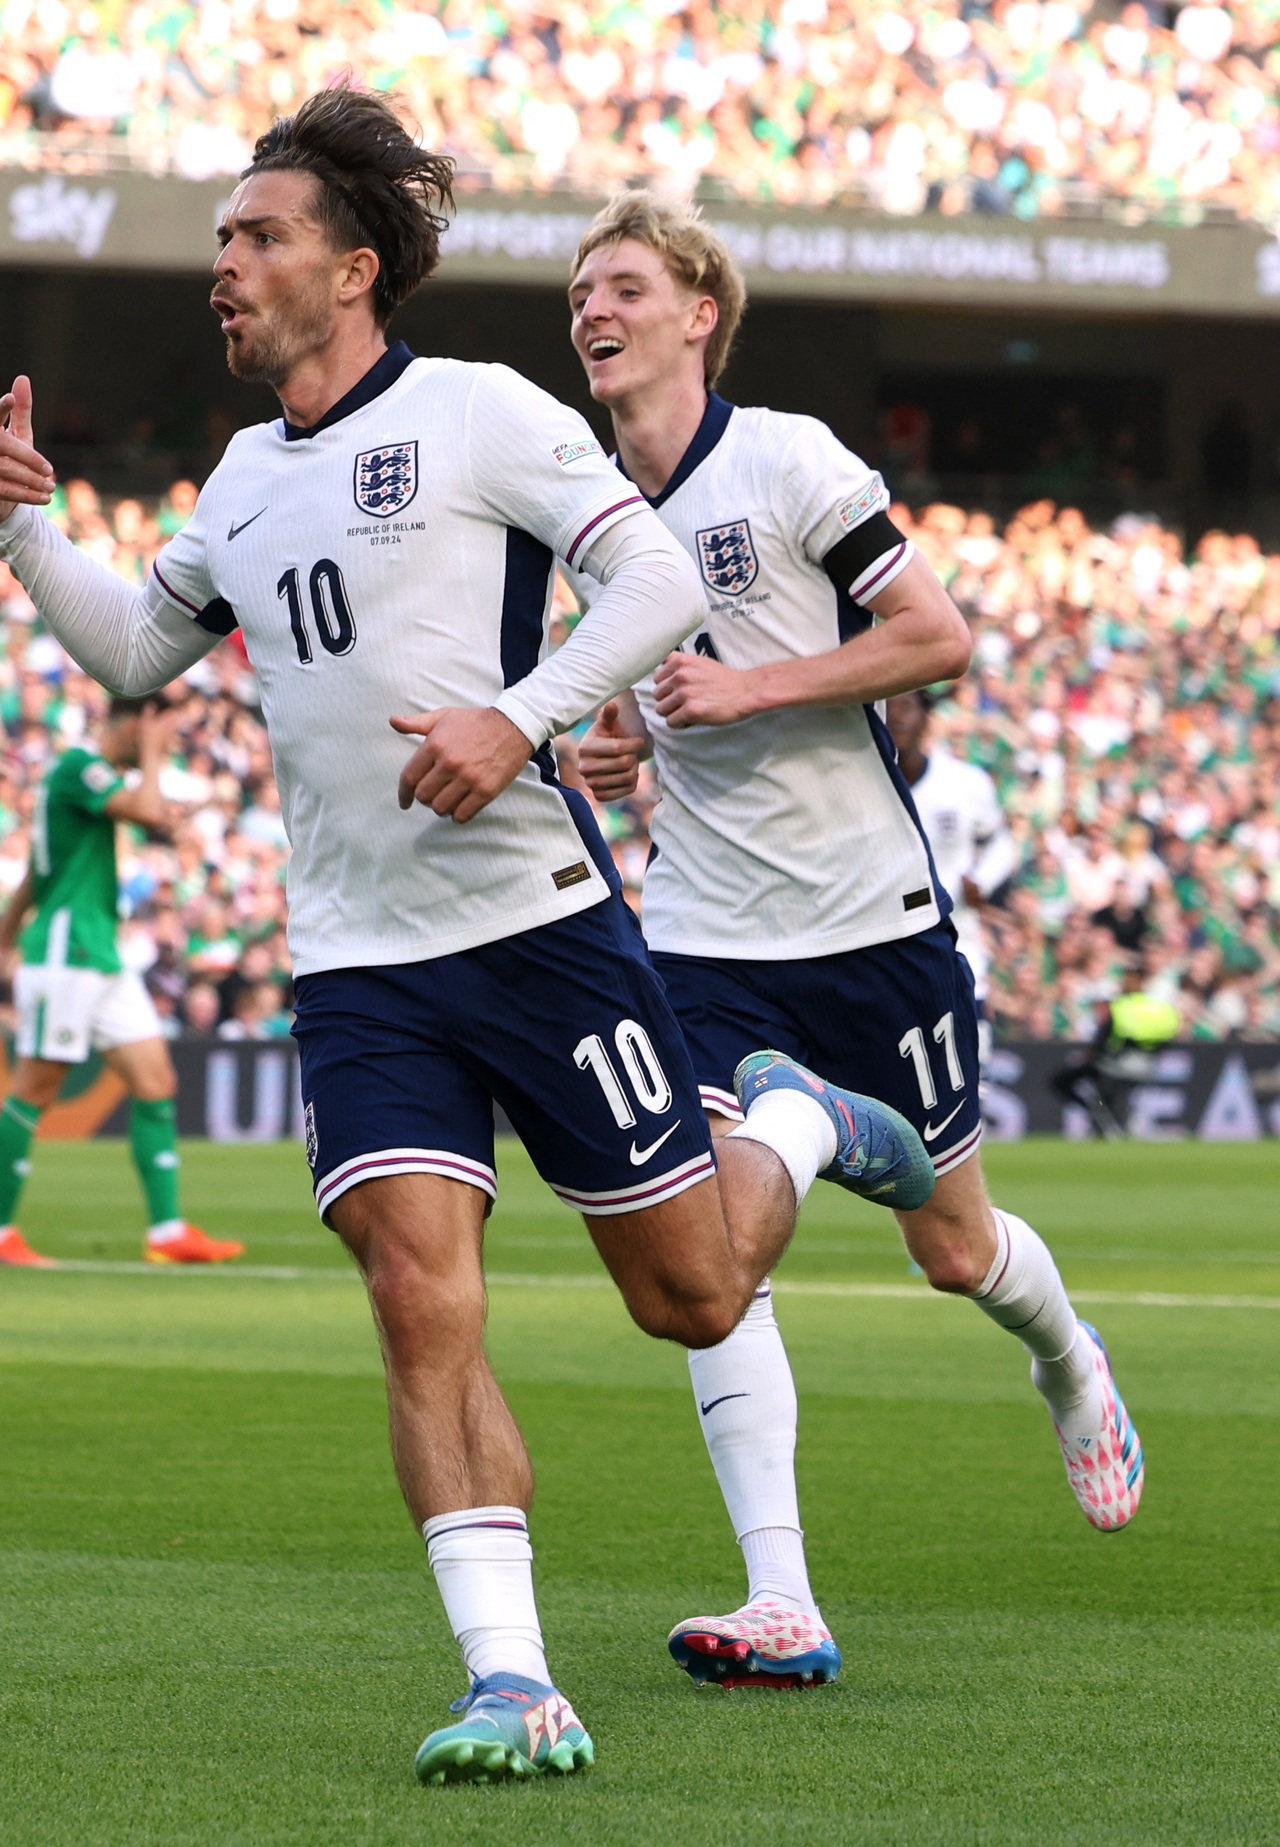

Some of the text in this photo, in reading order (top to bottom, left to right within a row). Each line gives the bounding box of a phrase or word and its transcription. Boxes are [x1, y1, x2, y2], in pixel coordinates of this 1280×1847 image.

[9, 174, 117, 259] sky
[765, 223, 847, 273] OUR
[849, 228, 1041, 283] NATIONAL
[1042, 236, 1168, 288] TEAMS
[551, 443, 568, 455] UEFA
[346, 521, 426, 537] REPUBLIC OF IRELAND
[370, 535, 401, 546] 07.09.24
[277, 558, 357, 664] 10
[572, 1018, 672, 1130] 10
[898, 1010, 966, 1110] 11
